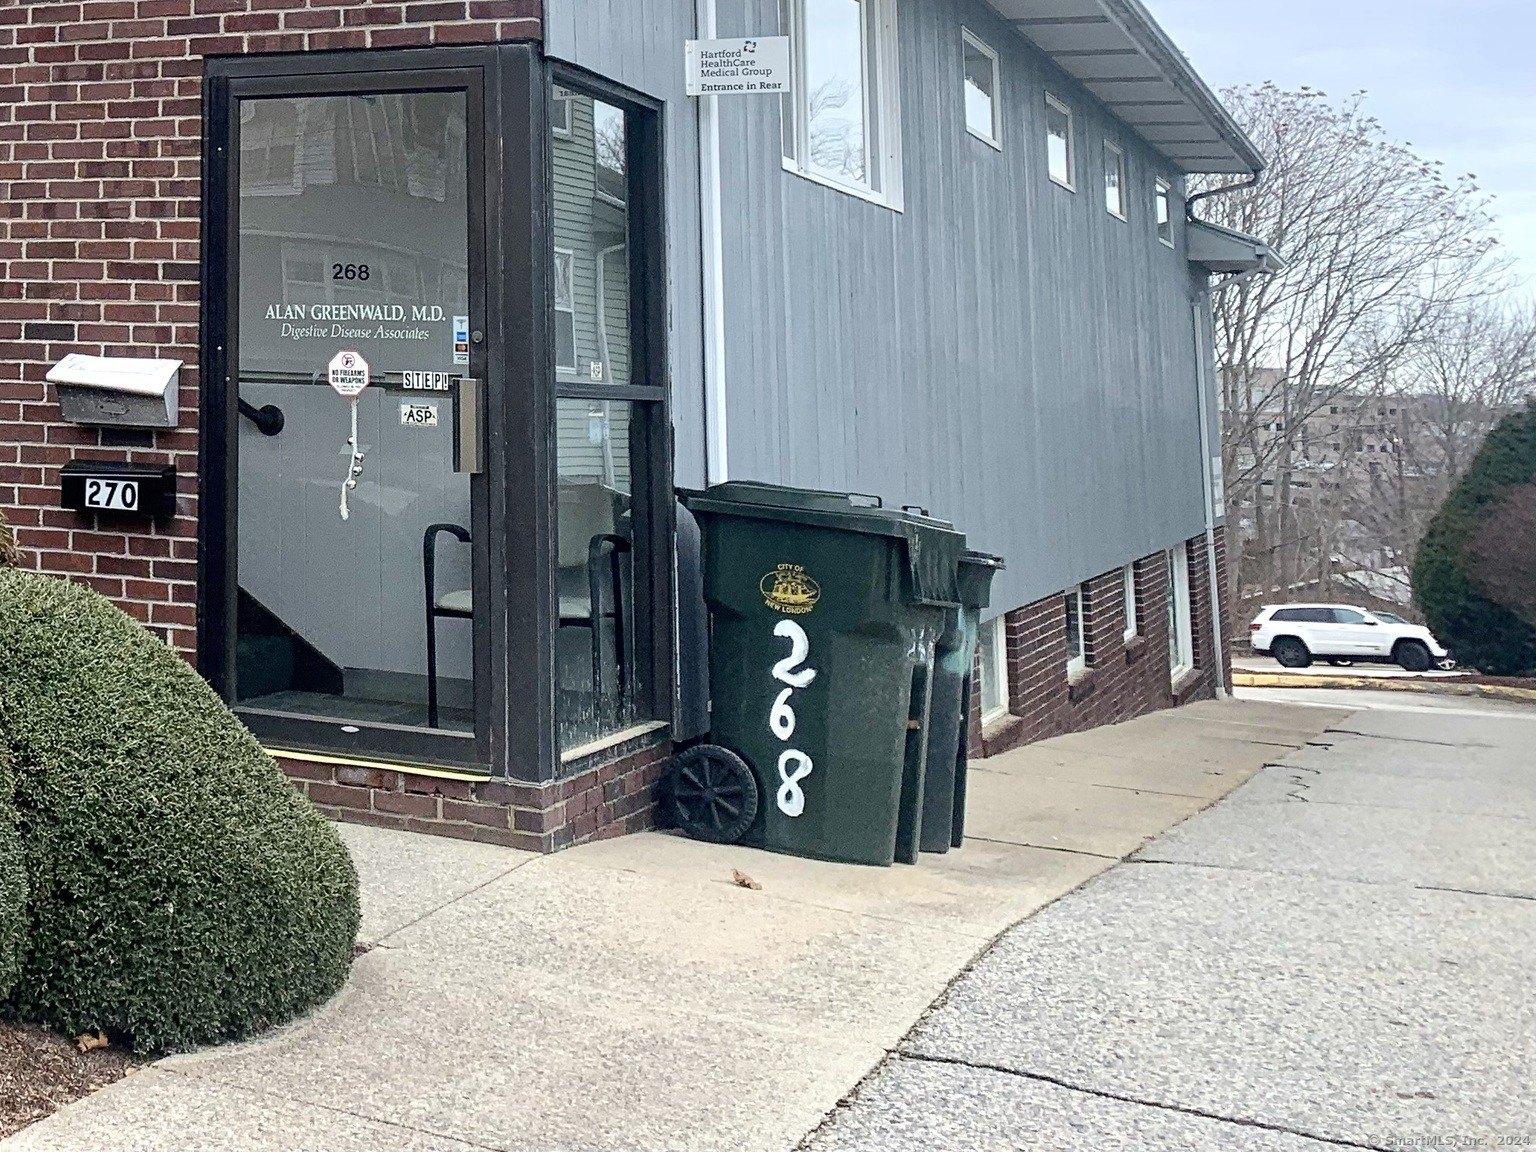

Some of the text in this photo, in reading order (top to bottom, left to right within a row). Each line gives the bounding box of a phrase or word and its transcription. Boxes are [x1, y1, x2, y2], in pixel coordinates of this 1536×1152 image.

[700, 49, 742, 59] Hartford
[700, 58, 756, 68] HealthCare
[700, 67, 773, 78] Medical Group
[701, 81, 782, 92] Entrance in Rear
[332, 263, 370, 281] 268
[265, 304, 446, 322] ALAN GREENWALD, M.D.
[281, 322, 430, 340] Digestive Disease Associates
[404, 372, 448, 389] STEP!
[406, 409, 432, 423] ASP
[88, 480, 137, 509] 270
[781, 605, 814, 614] LONDON
